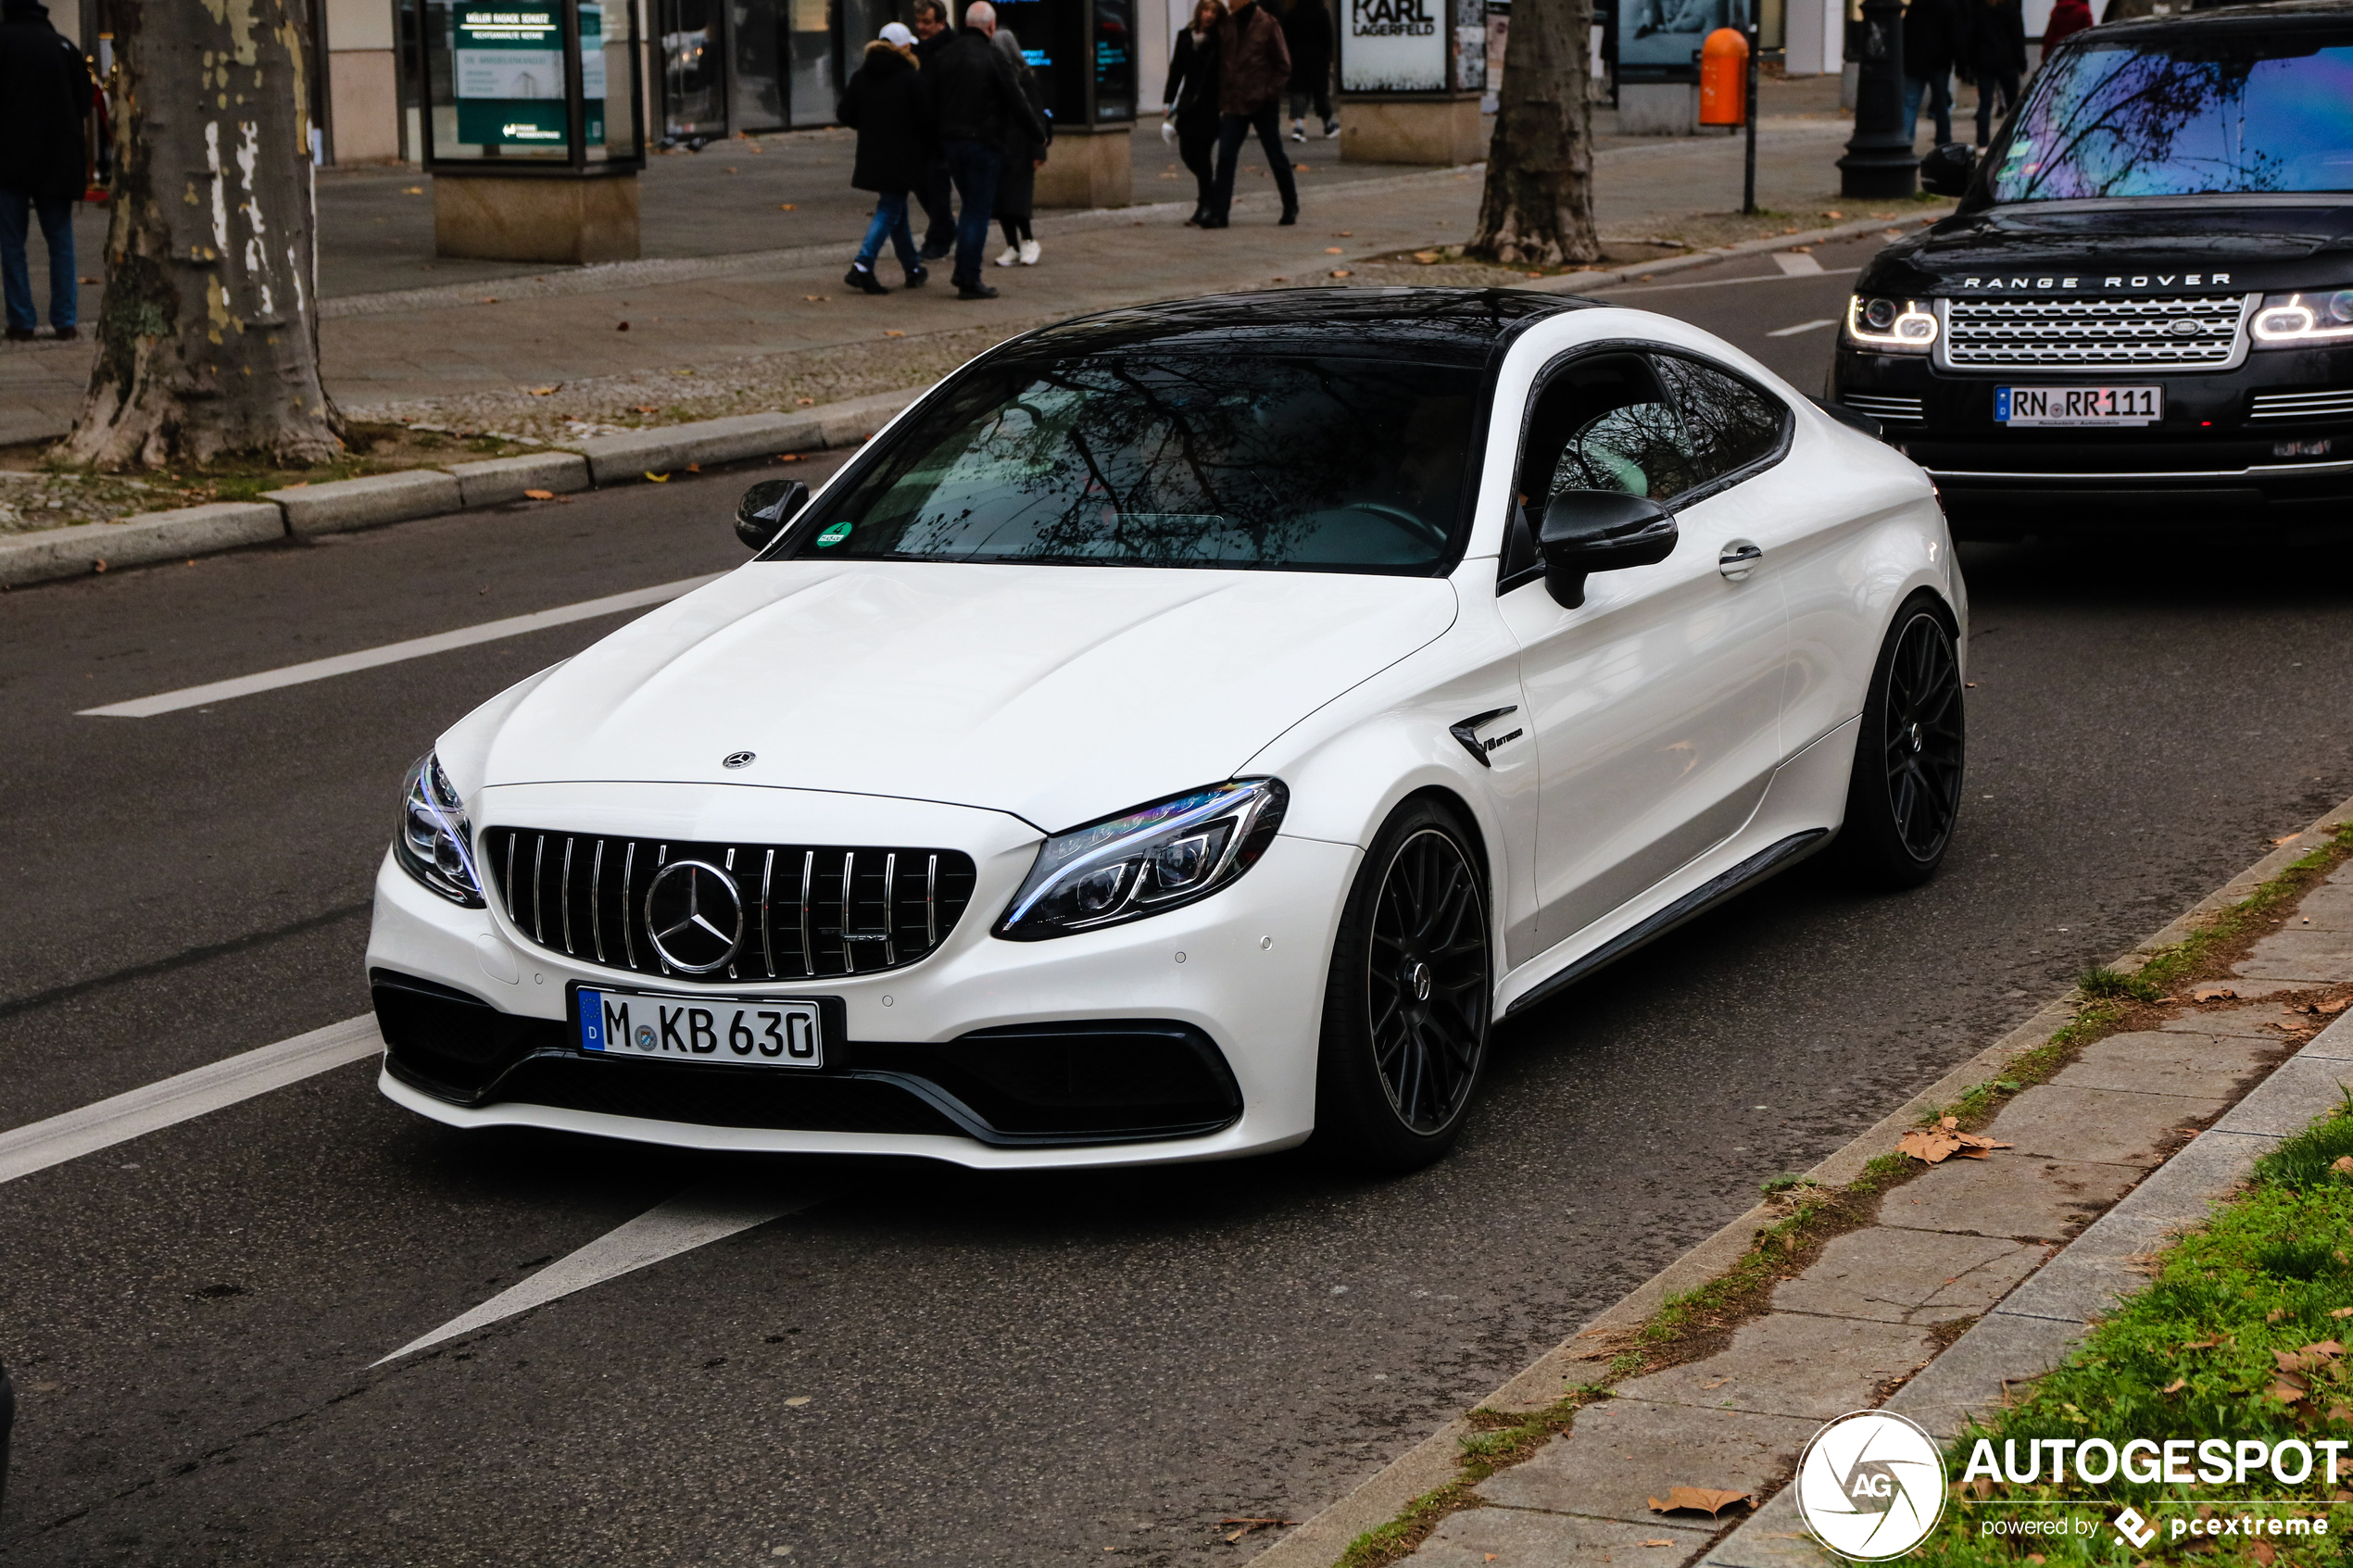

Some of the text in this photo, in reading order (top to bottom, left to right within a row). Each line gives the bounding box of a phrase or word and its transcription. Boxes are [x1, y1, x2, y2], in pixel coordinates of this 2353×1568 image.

[1353, 0, 1434, 22] KARL
[1353, 24, 1434, 36] LAGERFELD
[1964, 273, 2231, 289] RANGE ROVER
[2014, 391, 2046, 416] RN
[2066, 390, 2156, 416] RR111
[833, 522, 847, 534] 4
[588, 999, 814, 1059] D M KB 630
